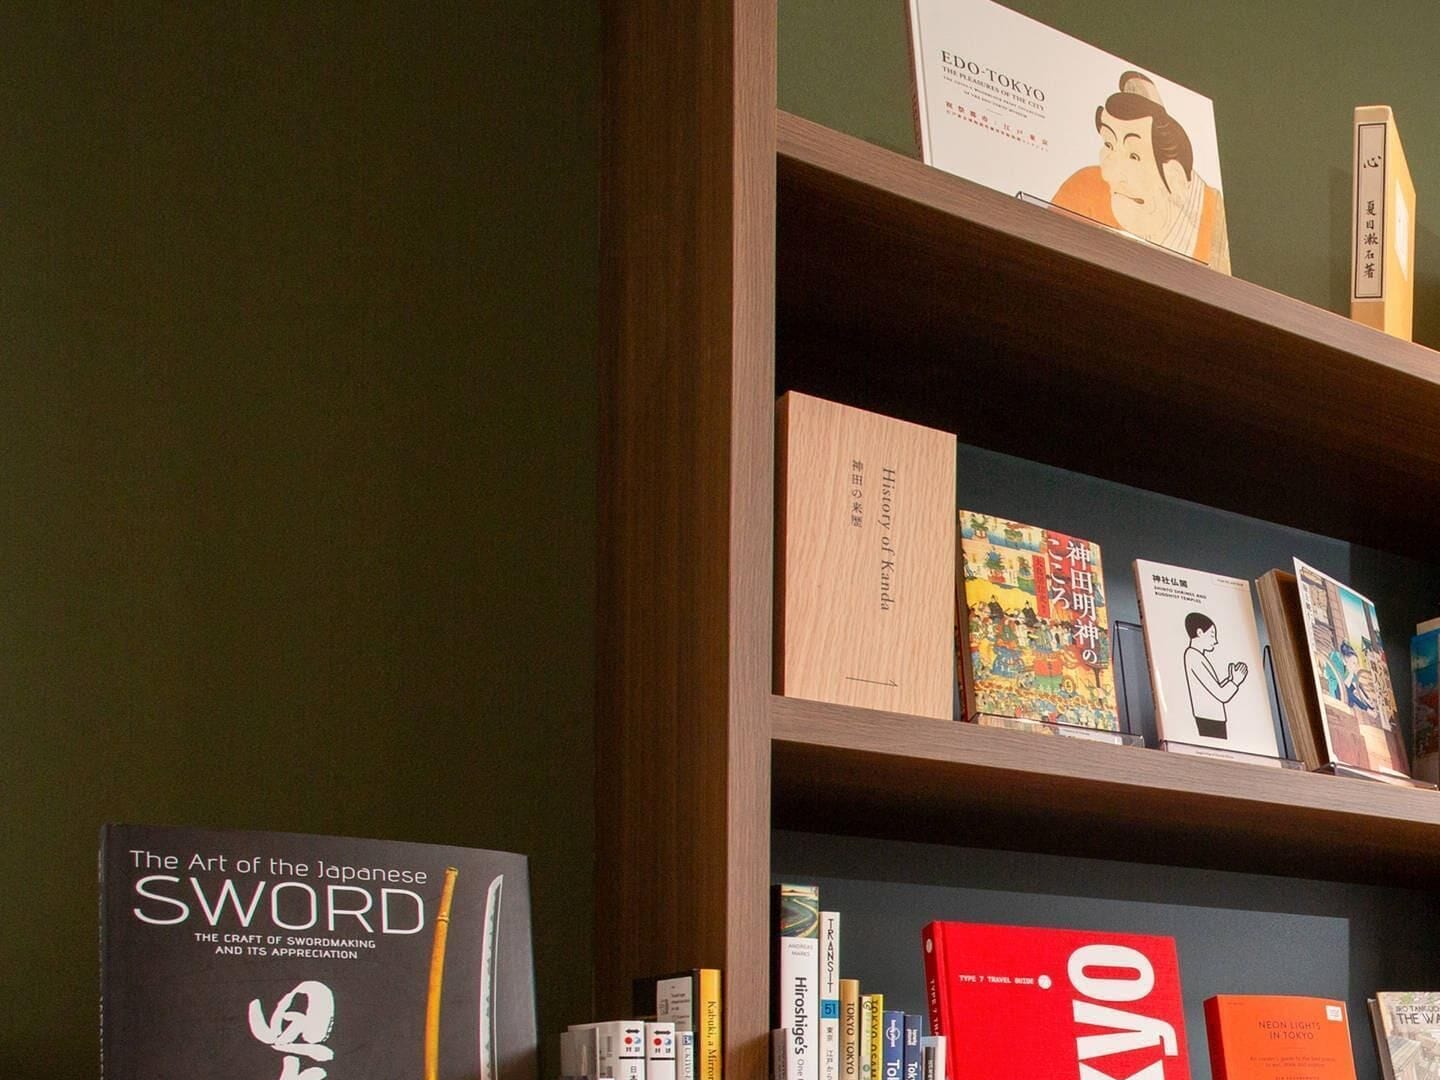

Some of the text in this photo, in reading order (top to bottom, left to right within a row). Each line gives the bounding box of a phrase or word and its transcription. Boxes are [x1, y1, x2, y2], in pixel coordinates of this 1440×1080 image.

[941, 50, 1045, 102] EDO-TOKYO
[1363, 155, 1382, 169] 心
[850, 459, 865, 529] 神田の来歴
[880, 466, 897, 612] History of Kanda
[129, 849, 428, 884] The Art of the Japanese
[133, 874, 425, 935] SWORD
[194, 932, 376, 949] THE CRAFT OF SWORDMAKING
[215, 945, 358, 960] AND ITS APPRECIATION
[826, 918, 835, 993] TRANSIT
[959, 975, 977, 983] TYPE
[987, 976, 1011, 985] TRAVEL
[1014, 977, 1035, 985] GUIDE
[792, 977, 808, 1055] Hiroshige's
[824, 1003, 836, 1016] 51
[845, 1002, 855, 1036] TOKYO
[1396, 1013, 1420, 1024] THE
[1284, 1031, 1314, 1040] TOKYO
[845, 1041, 855, 1075] TOKYO
